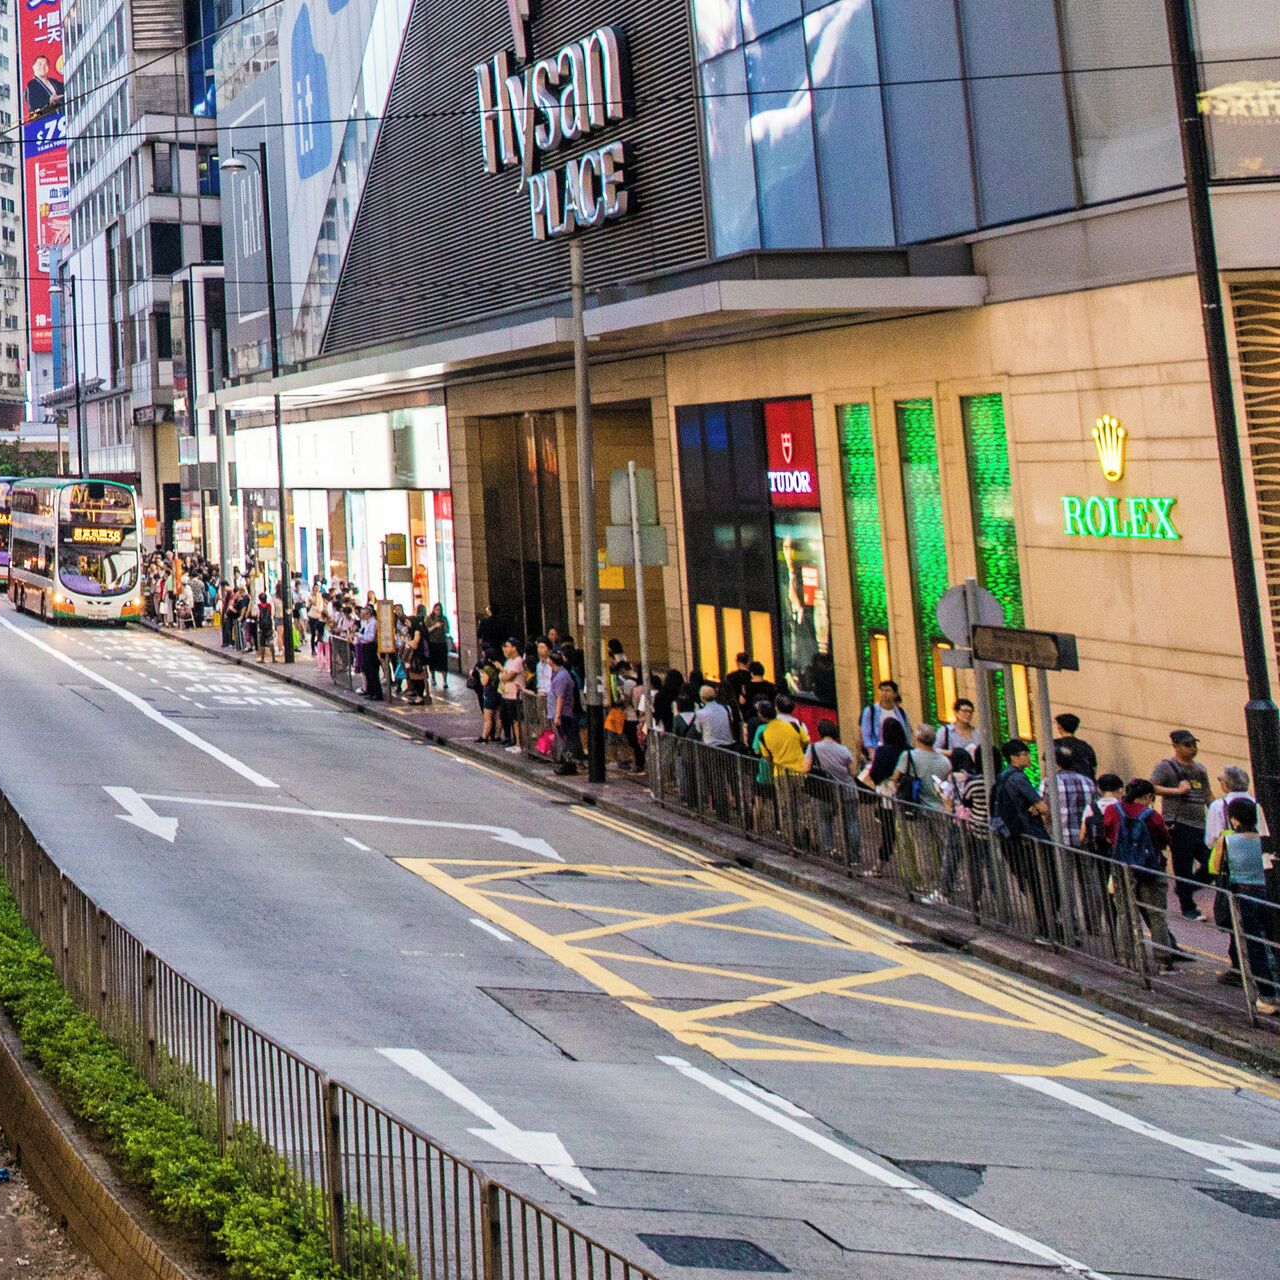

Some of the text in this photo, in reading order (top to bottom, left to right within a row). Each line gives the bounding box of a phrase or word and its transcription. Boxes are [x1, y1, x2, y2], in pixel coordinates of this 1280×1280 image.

[474, 24, 633, 193] Hysan
[528, 140, 635, 242] PLACE
[767, 470, 812, 494] TUDOR
[107, 529, 121, 542] 38
[1061, 496, 1180, 540] ROLEX
